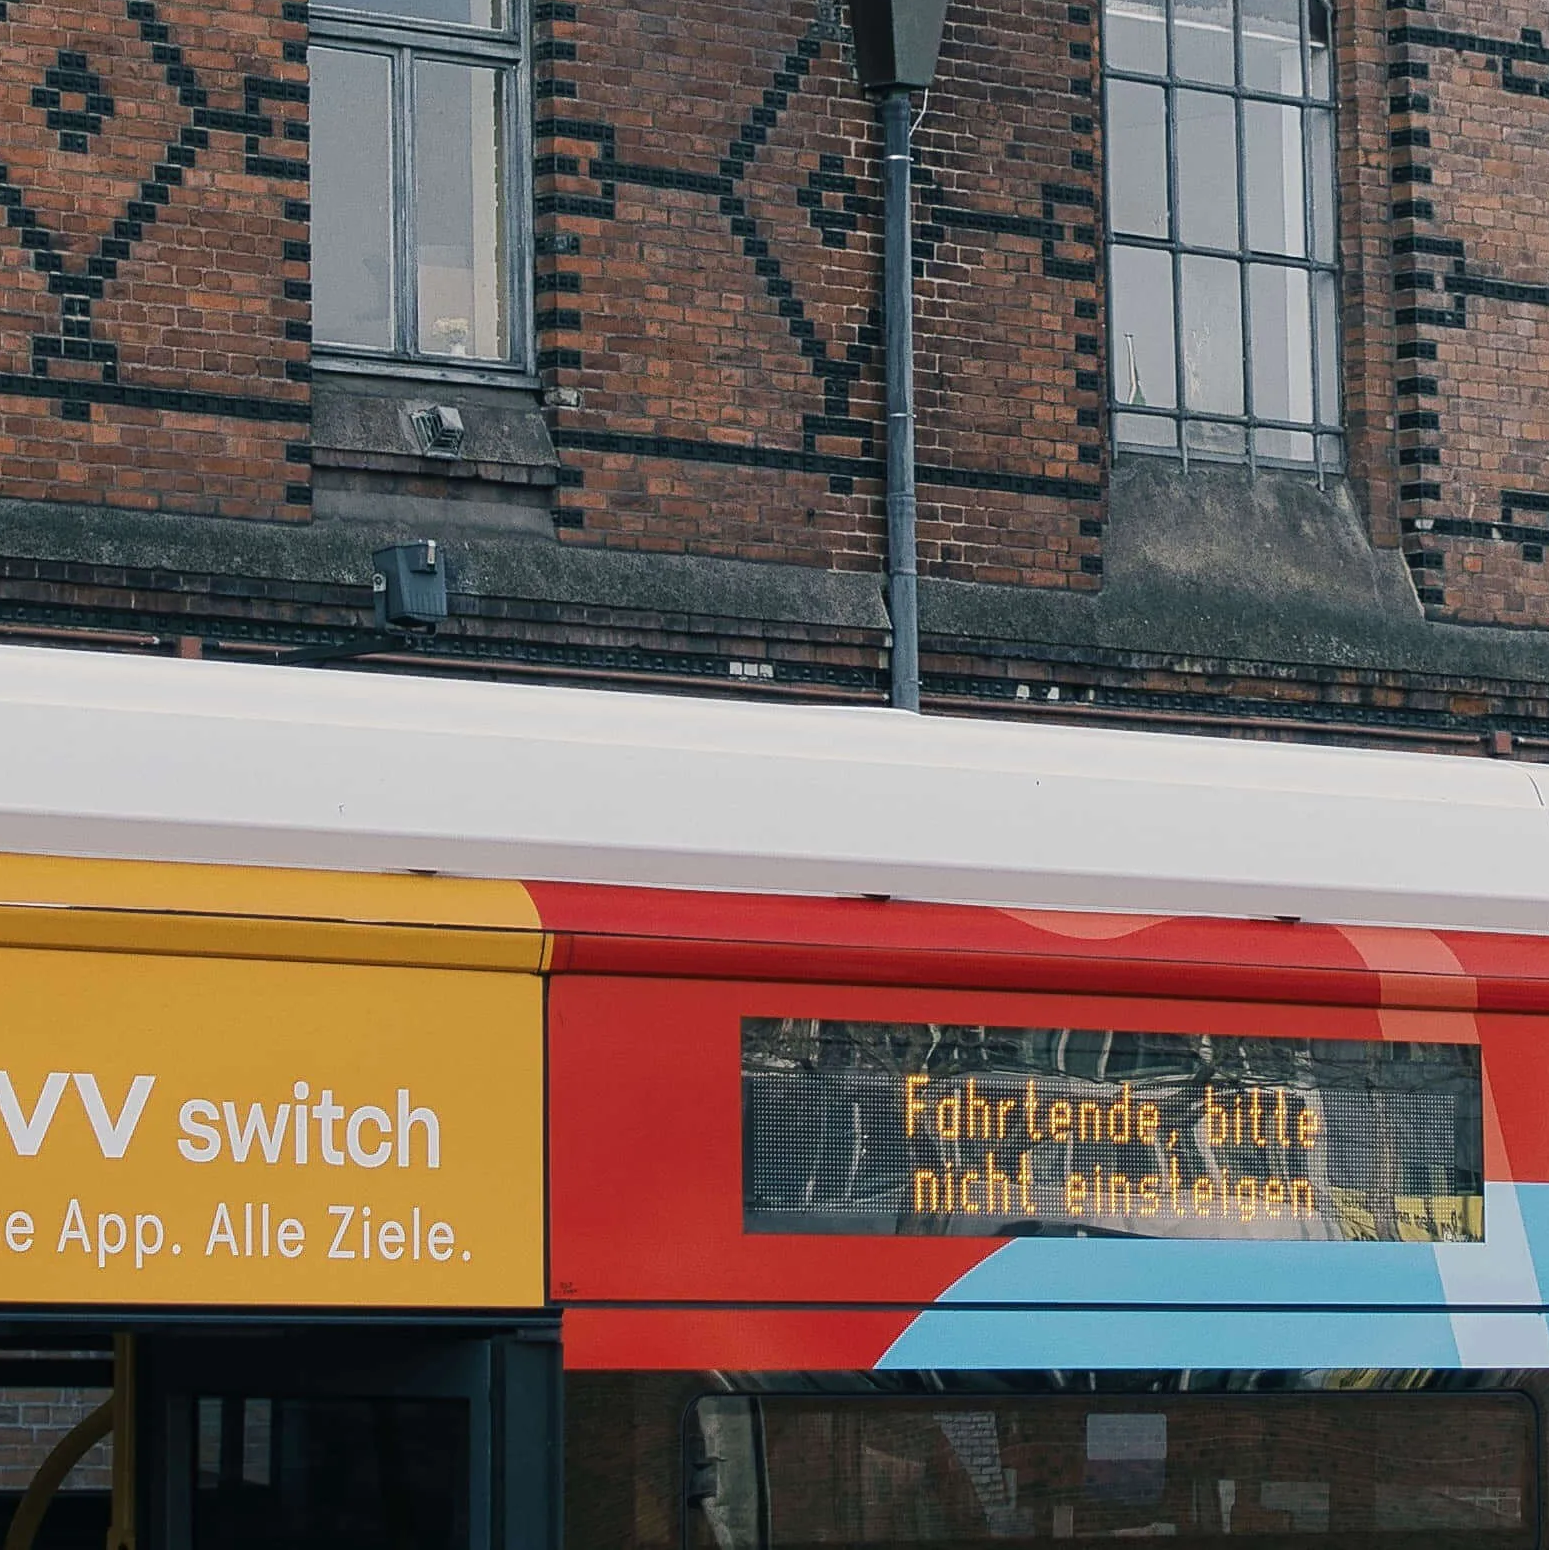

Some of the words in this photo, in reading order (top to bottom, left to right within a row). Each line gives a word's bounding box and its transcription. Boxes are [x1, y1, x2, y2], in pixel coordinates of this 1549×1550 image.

[177, 1080, 441, 1168] switch
[906, 1075, 1180, 1152] Fahrtende,
[1207, 1087, 1319, 1149] bitte
[913, 1150, 1036, 1216] nicht
[1065, 1154, 1317, 1222] einsteigen
[57, 1198, 182, 1269] App.
[205, 1202, 306, 1259] Alle
[327, 1205, 472, 1262] Ziele.
